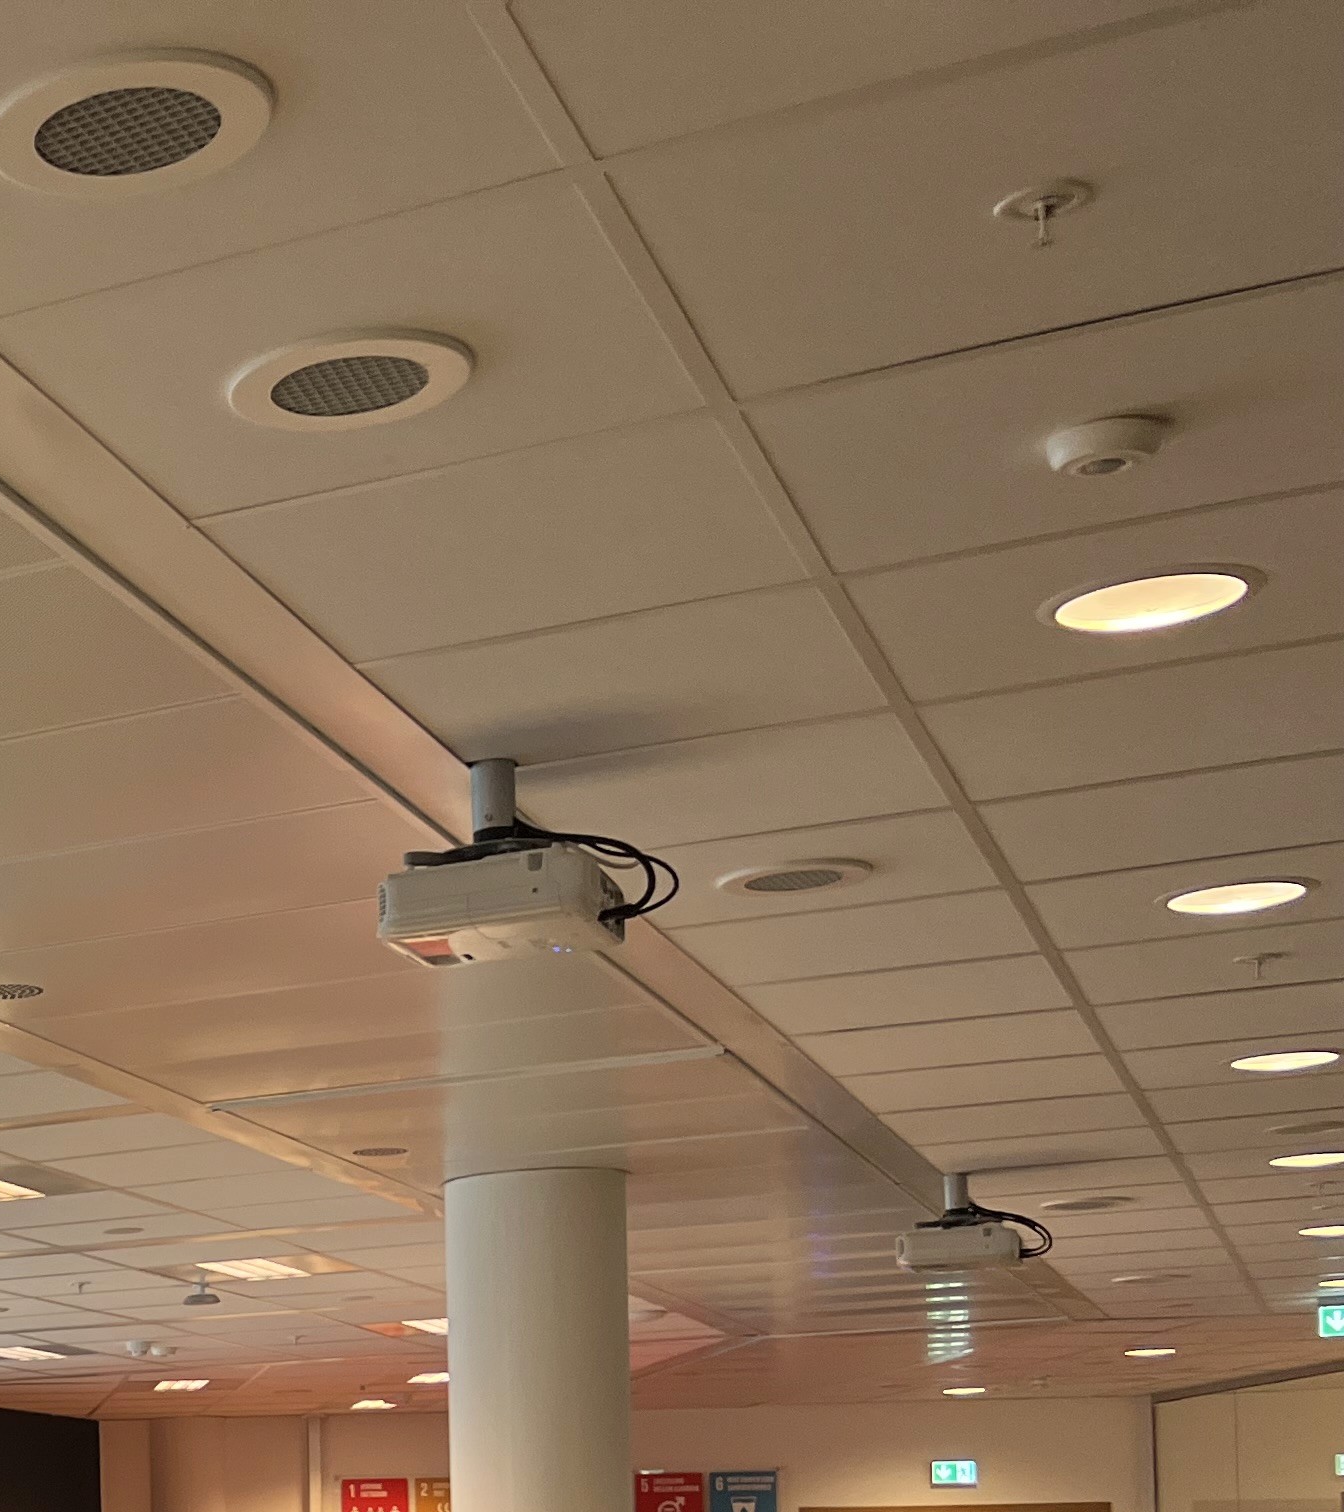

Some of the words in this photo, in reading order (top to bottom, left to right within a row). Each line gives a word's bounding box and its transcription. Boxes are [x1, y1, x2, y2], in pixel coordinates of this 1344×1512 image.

[420, 1483, 428, 1497] 2
[640, 1478, 649, 1492] 5
[715, 1476, 724, 1491] 6
